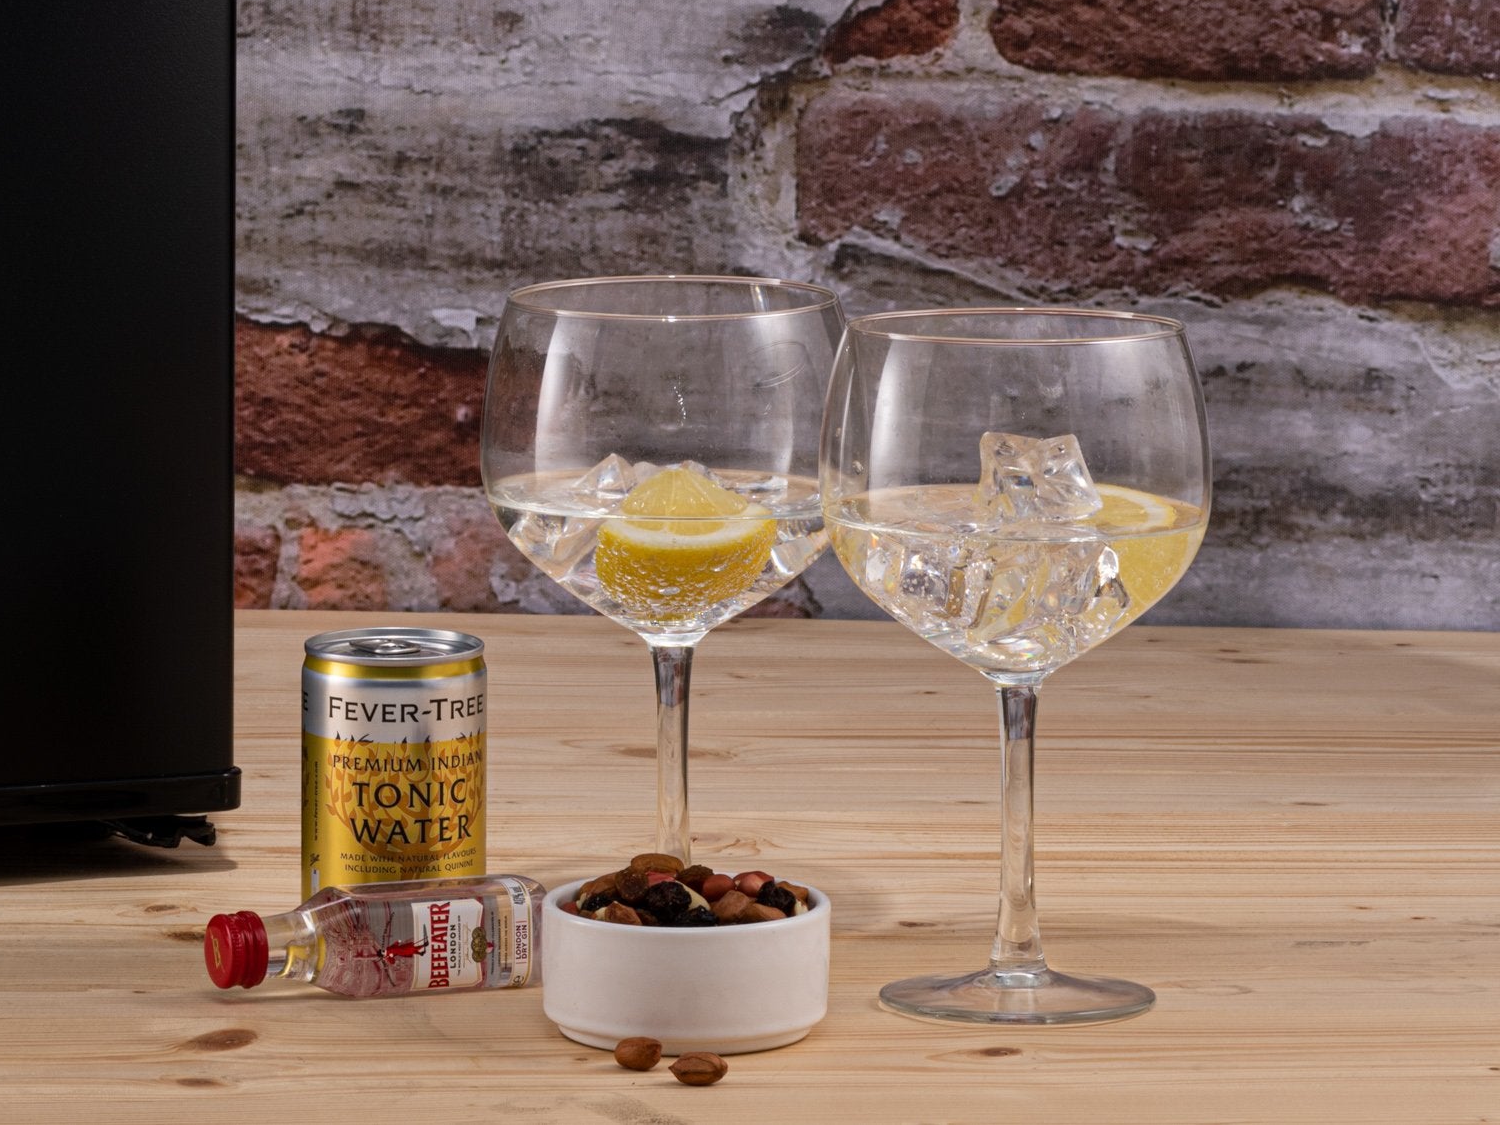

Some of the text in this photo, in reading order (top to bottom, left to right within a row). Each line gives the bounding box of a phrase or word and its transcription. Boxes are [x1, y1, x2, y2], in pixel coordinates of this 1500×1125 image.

[328, 693, 484, 723] FEVER-TREE
[333, 748, 483, 773] PREMIUM INDIAN
[352, 778, 467, 809] TONIC
[350, 814, 473, 845] WATER
[340, 847, 477, 863] MADE WITH NATURAL FLAVOURS
[344, 859, 474, 874] INCLUDING NATURAL QUININE
[428, 901, 451, 988] BEEFEATER
